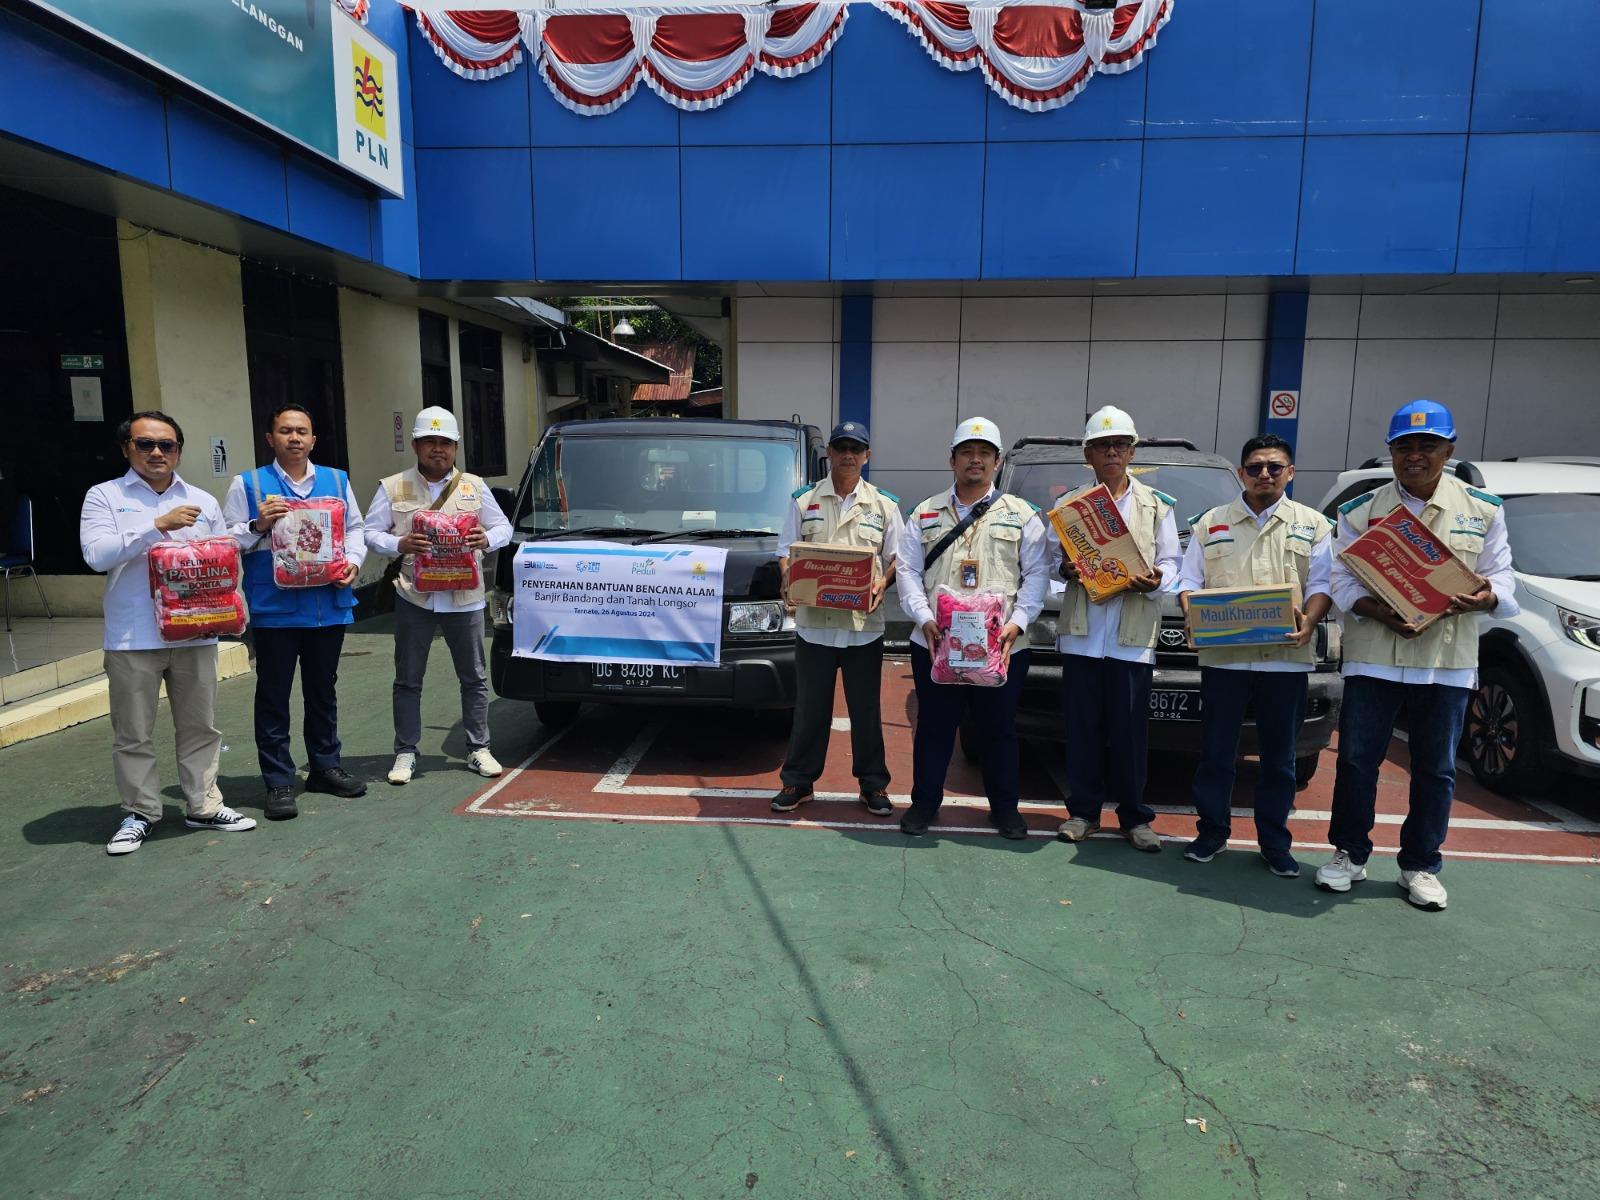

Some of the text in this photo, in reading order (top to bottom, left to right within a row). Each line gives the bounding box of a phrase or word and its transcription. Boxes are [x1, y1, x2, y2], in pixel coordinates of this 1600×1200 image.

[355, 129, 389, 170] PLN
[180, 557, 219, 567] SELIMUT
[169, 566, 230, 580] PAULINA
[631, 566, 656, 575] Peduli
[188, 580, 222, 590] BONITA
[522, 580, 715, 597] PENYERAHAN BANTUAN BENCANA ALAM
[1384, 567, 1427, 605] goreng
[534, 591, 698, 610] Banjir Bandang dan Tanah Longsor
[574, 607, 600, 615] Ternate,
[610, 609, 638, 617] Agustus
[1200, 606, 1282, 622] MaulKhairaat
[596, 662, 613, 677] DG
[621, 663, 654, 678] 8408
[1149, 691, 1189, 711] 8672
